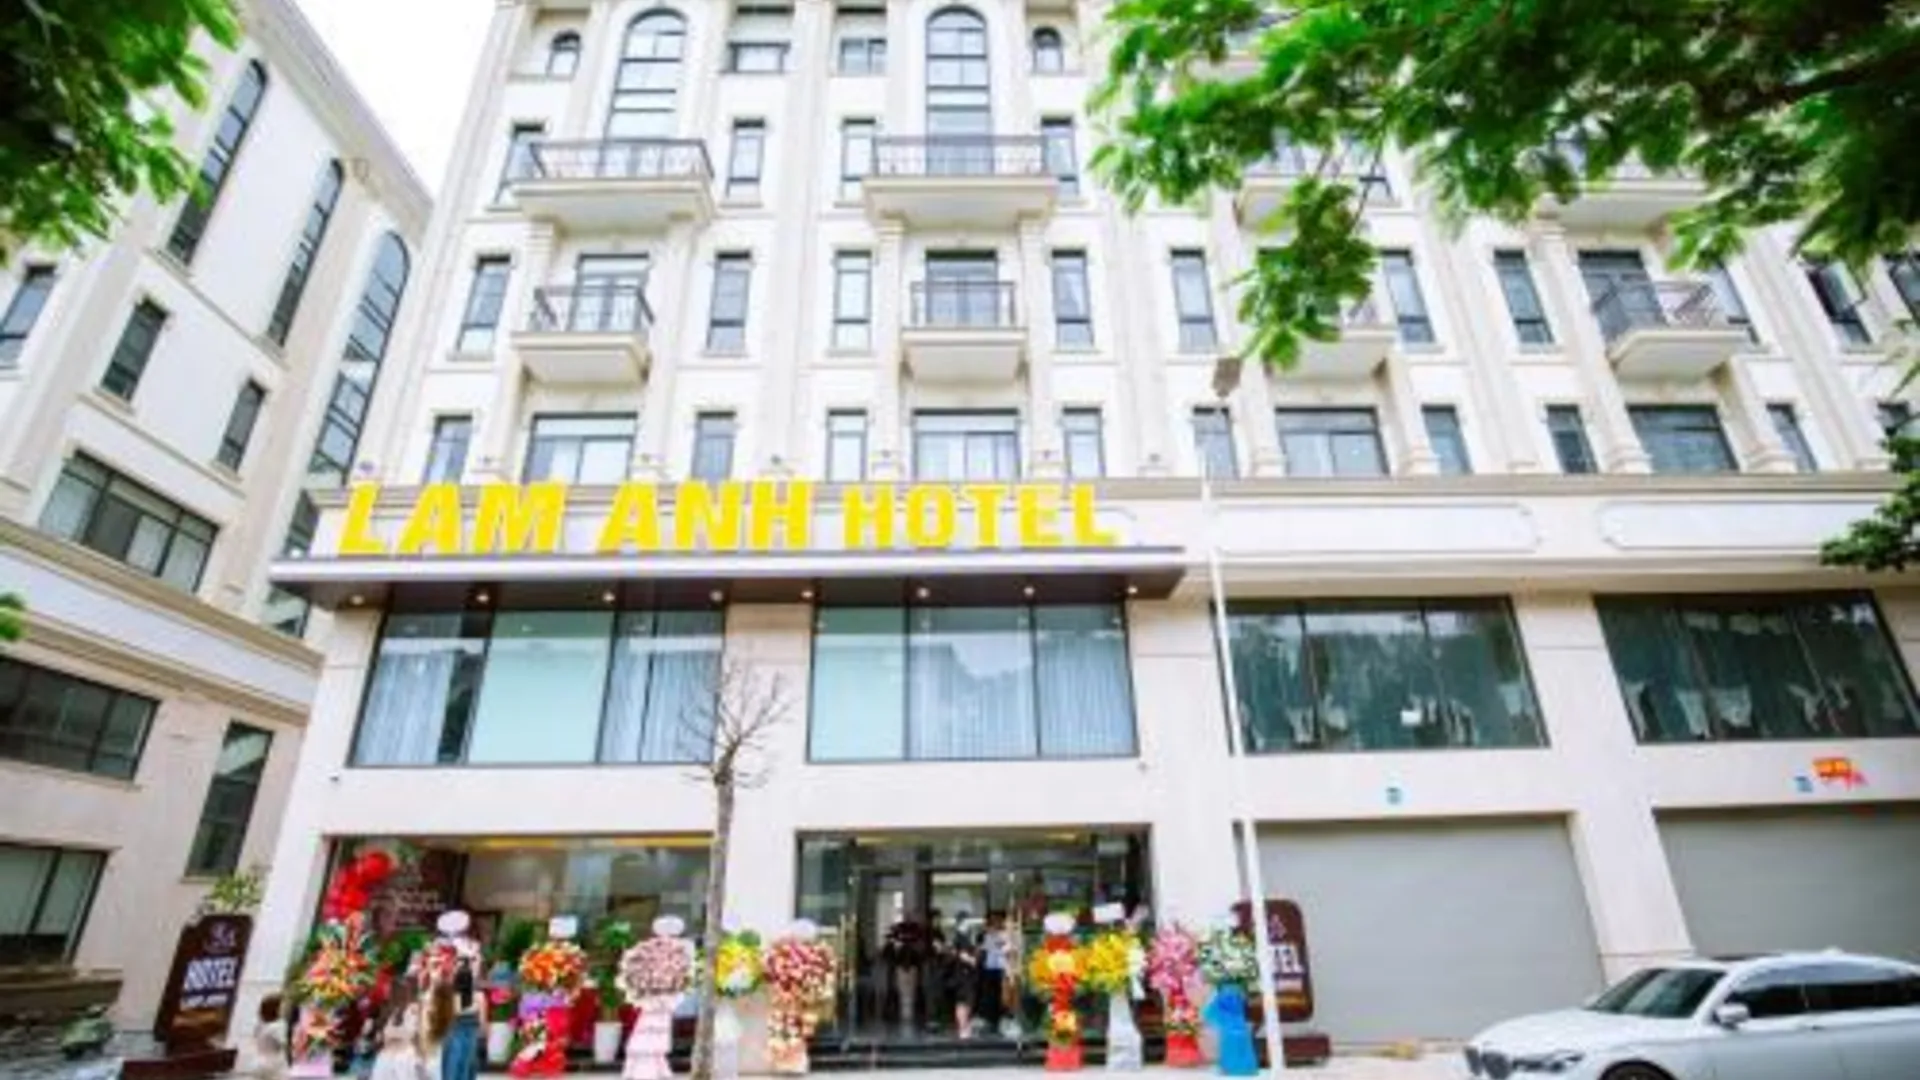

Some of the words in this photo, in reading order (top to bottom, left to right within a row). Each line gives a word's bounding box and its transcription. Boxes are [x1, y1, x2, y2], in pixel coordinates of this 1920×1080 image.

[338, 481, 568, 555] LAM
[597, 479, 812, 553] ANH
[841, 482, 1117, 549] HOTEL
[184, 957, 239, 990] HOTEL
